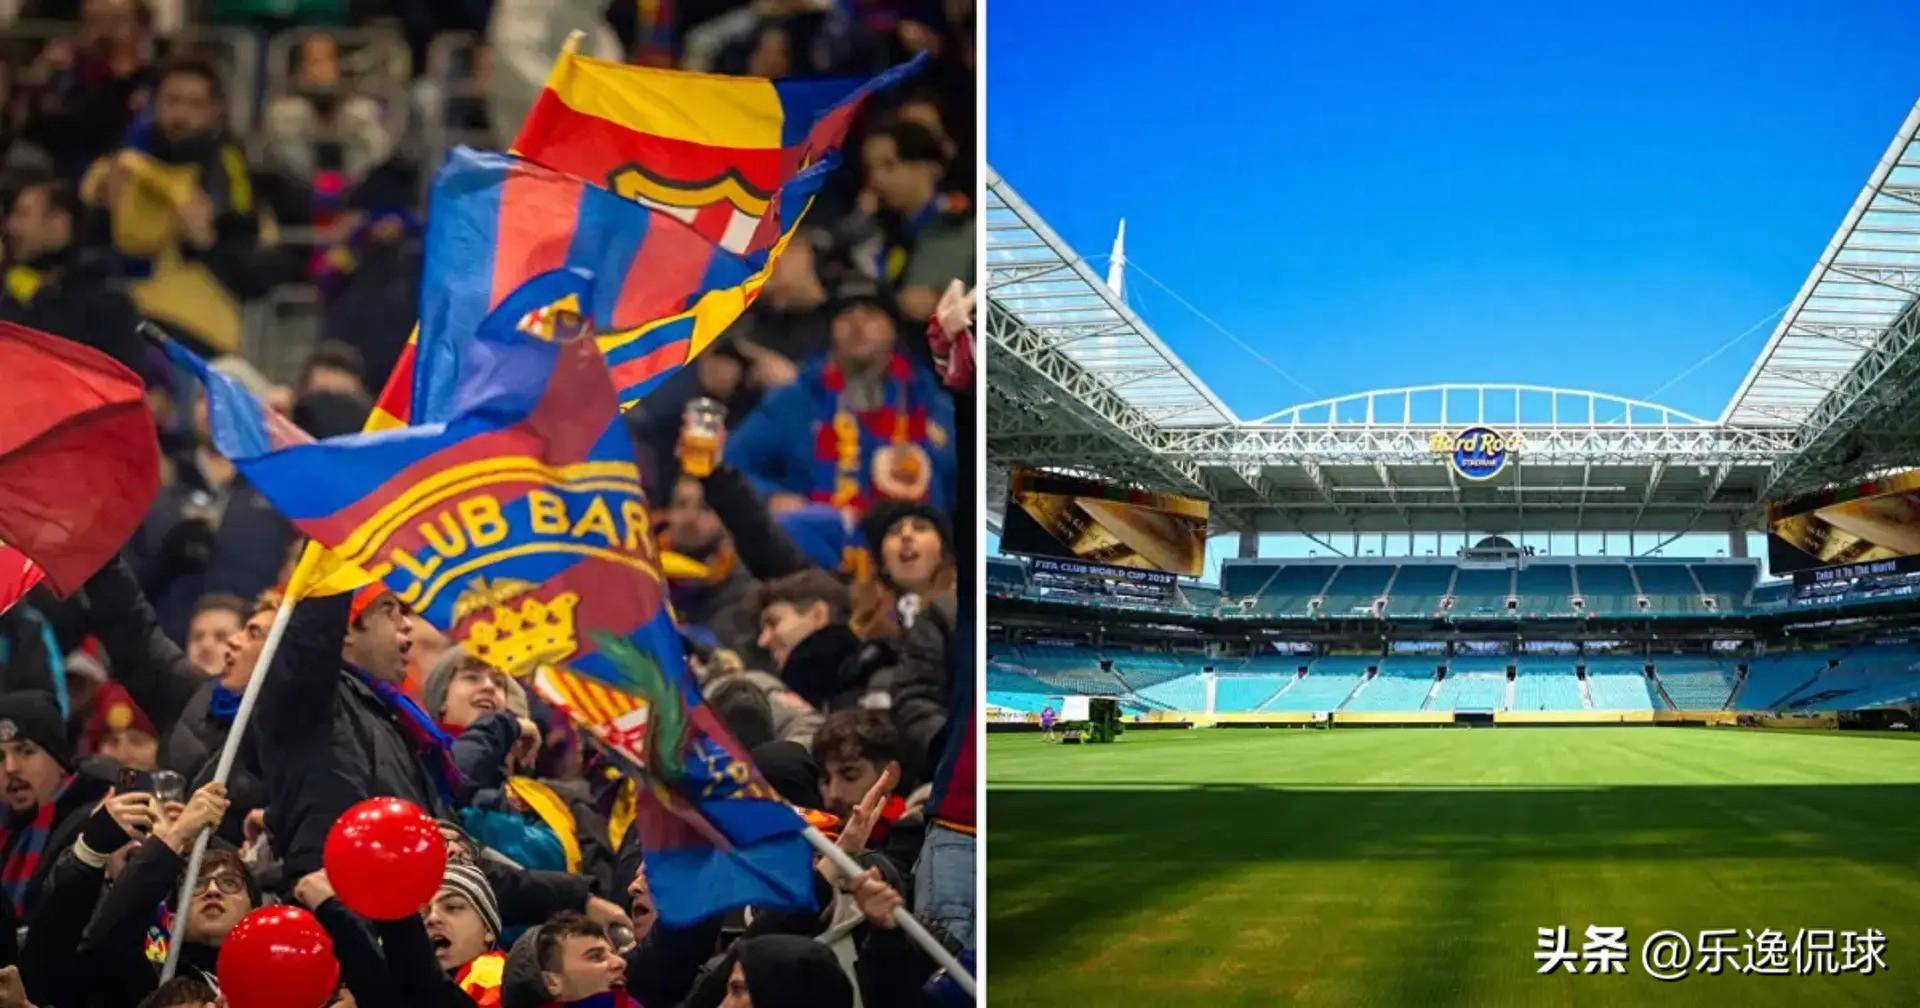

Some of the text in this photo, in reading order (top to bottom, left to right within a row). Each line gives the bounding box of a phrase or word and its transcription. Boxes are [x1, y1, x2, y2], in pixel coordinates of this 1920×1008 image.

[1429, 431, 1526, 456] Hard Rock
[1035, 560, 1058, 571] FIFA
[1060, 563, 1087, 574] CLUB
[1089, 566, 1125, 578] WORLD
[1126, 571, 1146, 580] CUP
[1815, 570, 1834, 581] Take
[1870, 560, 1896, 573] World
